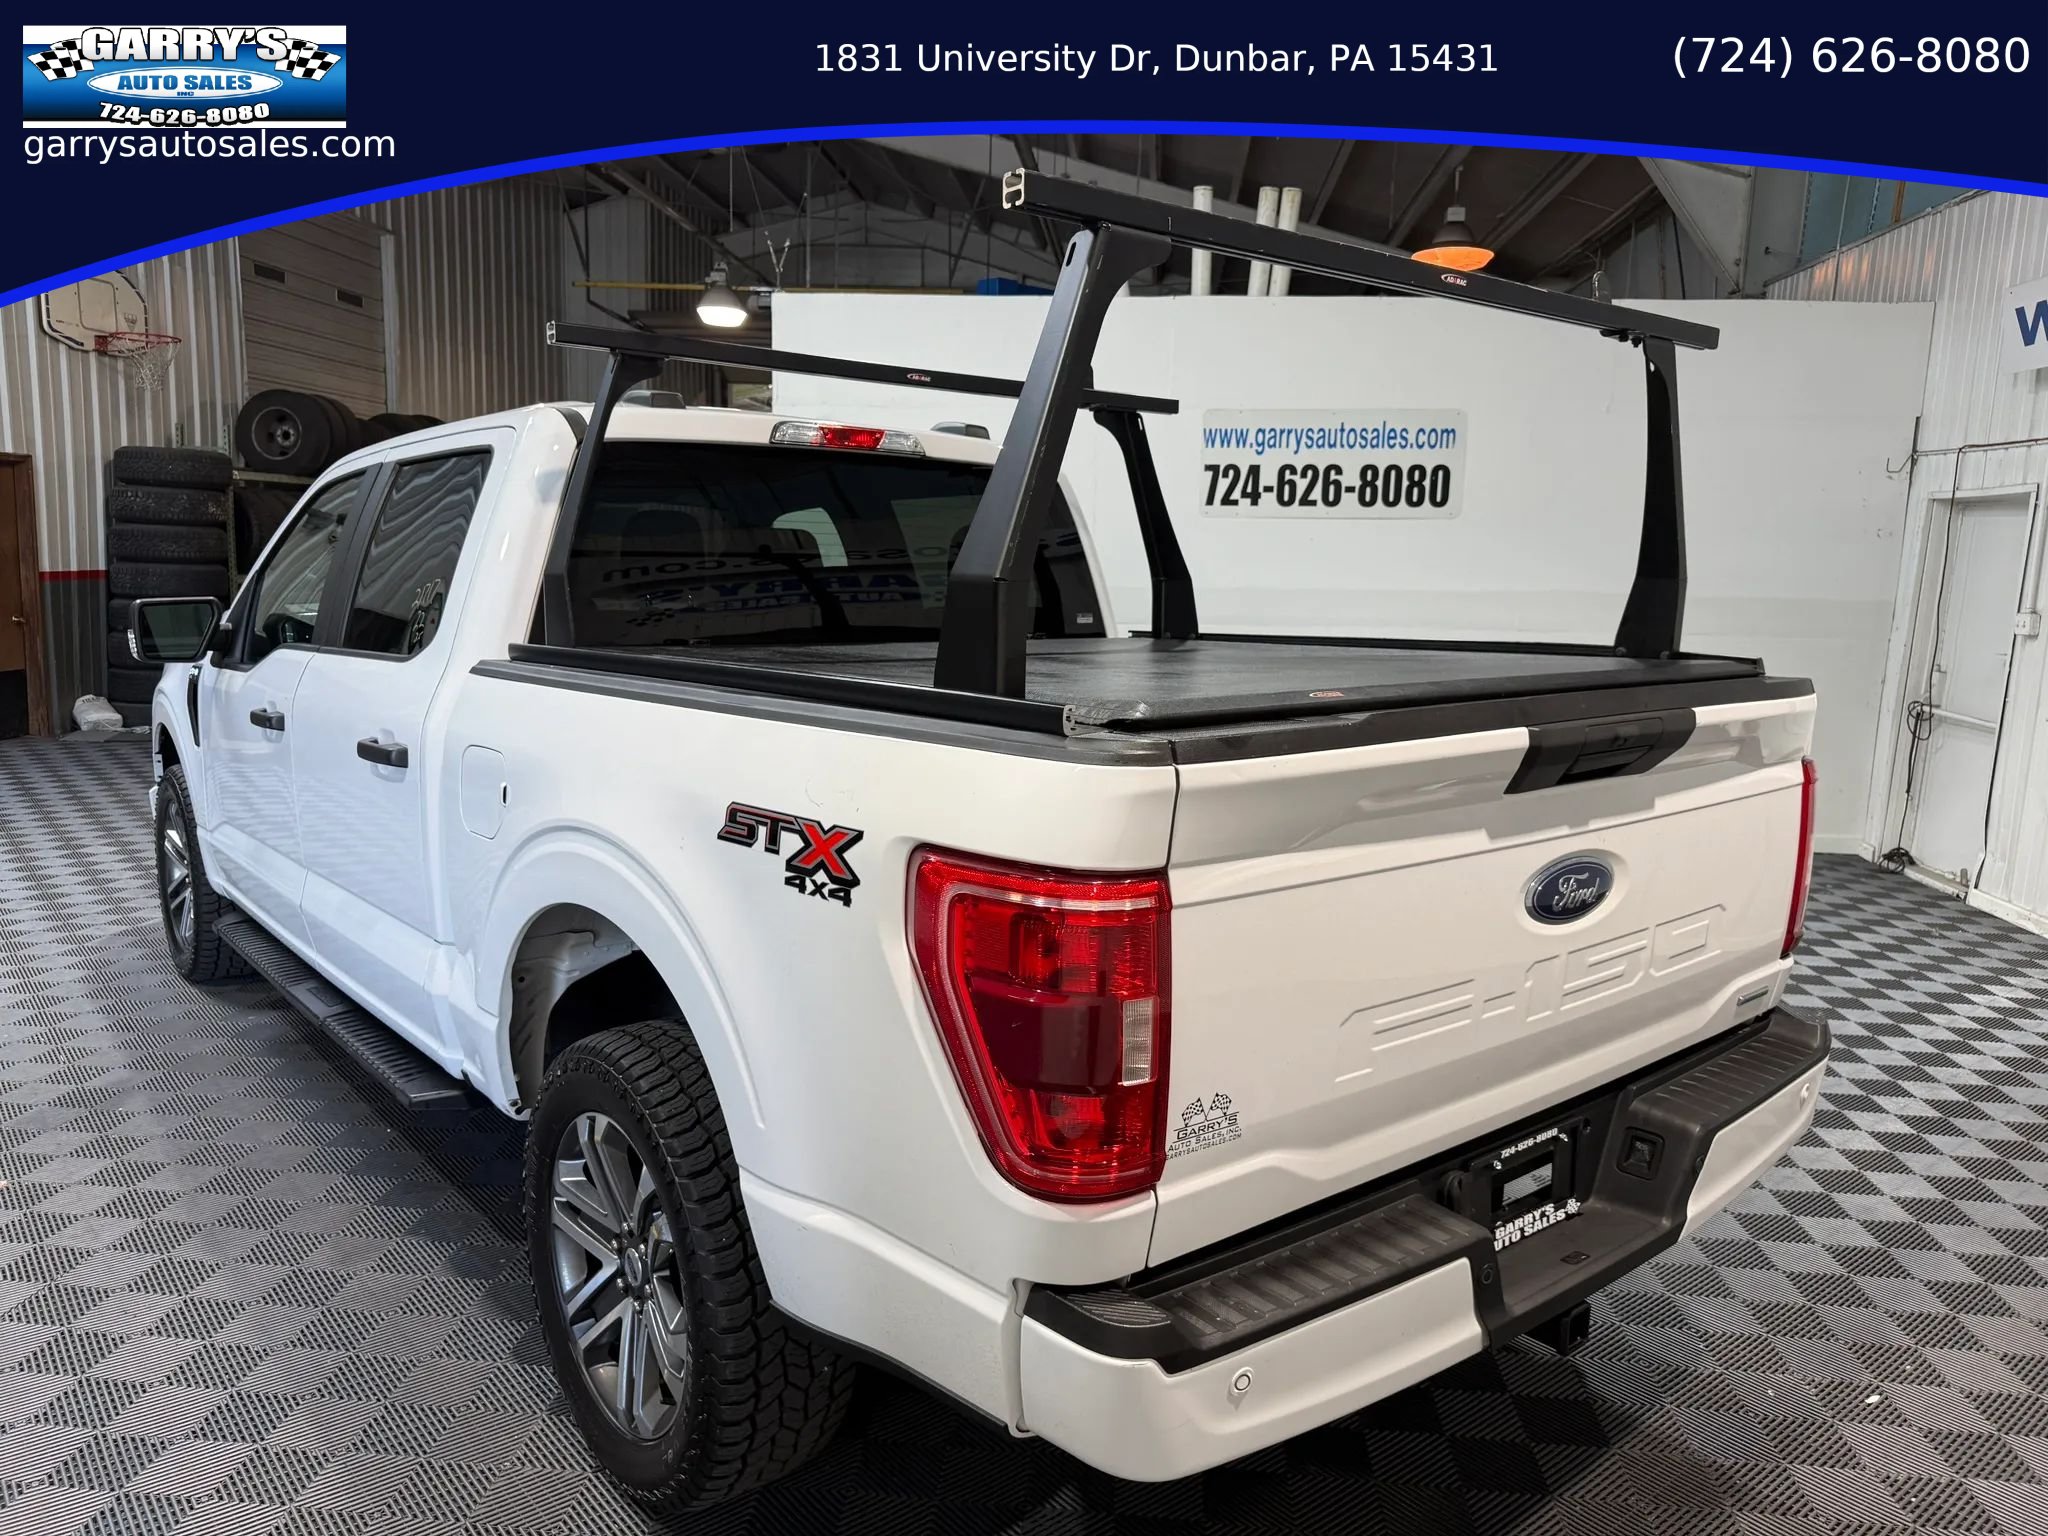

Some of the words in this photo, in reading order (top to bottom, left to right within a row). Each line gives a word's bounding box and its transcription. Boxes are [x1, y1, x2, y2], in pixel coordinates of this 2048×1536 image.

[1202, 420, 1457, 456] www.garrysautosales.com
[1203, 463, 1452, 508] 724-626-8080
[717, 801, 864, 888] STX
[1552, 872, 1600, 912] Ford
[1334, 903, 1727, 1082] F-150
[1176, 1114, 1238, 1140] GARRY'S
[1500, 1127, 1559, 1159] 724-626-8080
[1167, 1140, 1192, 1153] AUTO
[1493, 1230, 1522, 1252] UTO
[1523, 1208, 1567, 1237] SALES
[1494, 1203, 1556, 1240] GARRY'S
